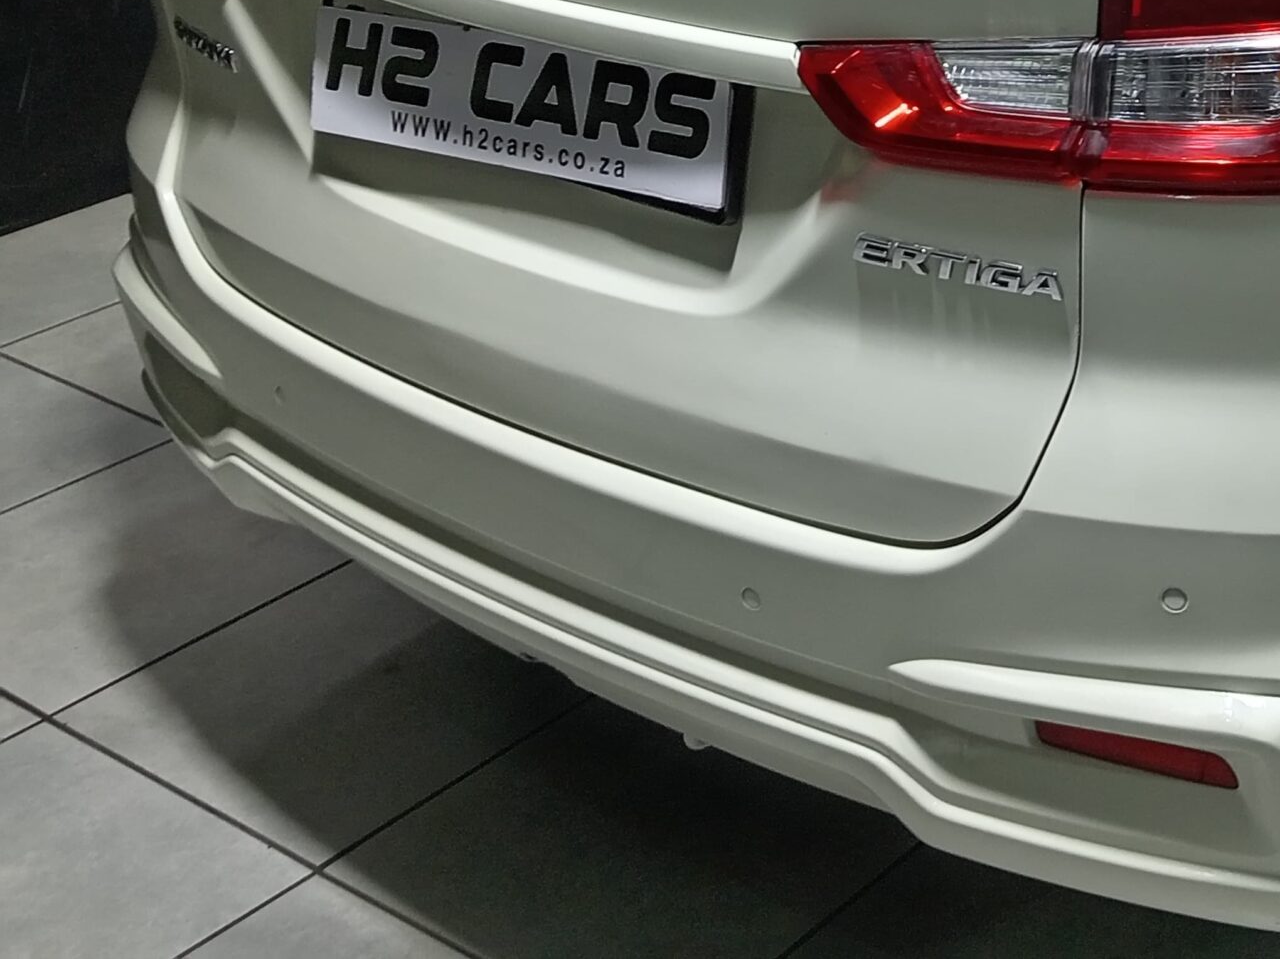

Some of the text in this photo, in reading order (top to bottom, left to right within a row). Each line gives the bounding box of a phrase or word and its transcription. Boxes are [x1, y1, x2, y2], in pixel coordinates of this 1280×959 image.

[325, 17, 440, 108] H2
[469, 41, 718, 160] CARS
[852, 231, 1063, 302] ERTIGA
